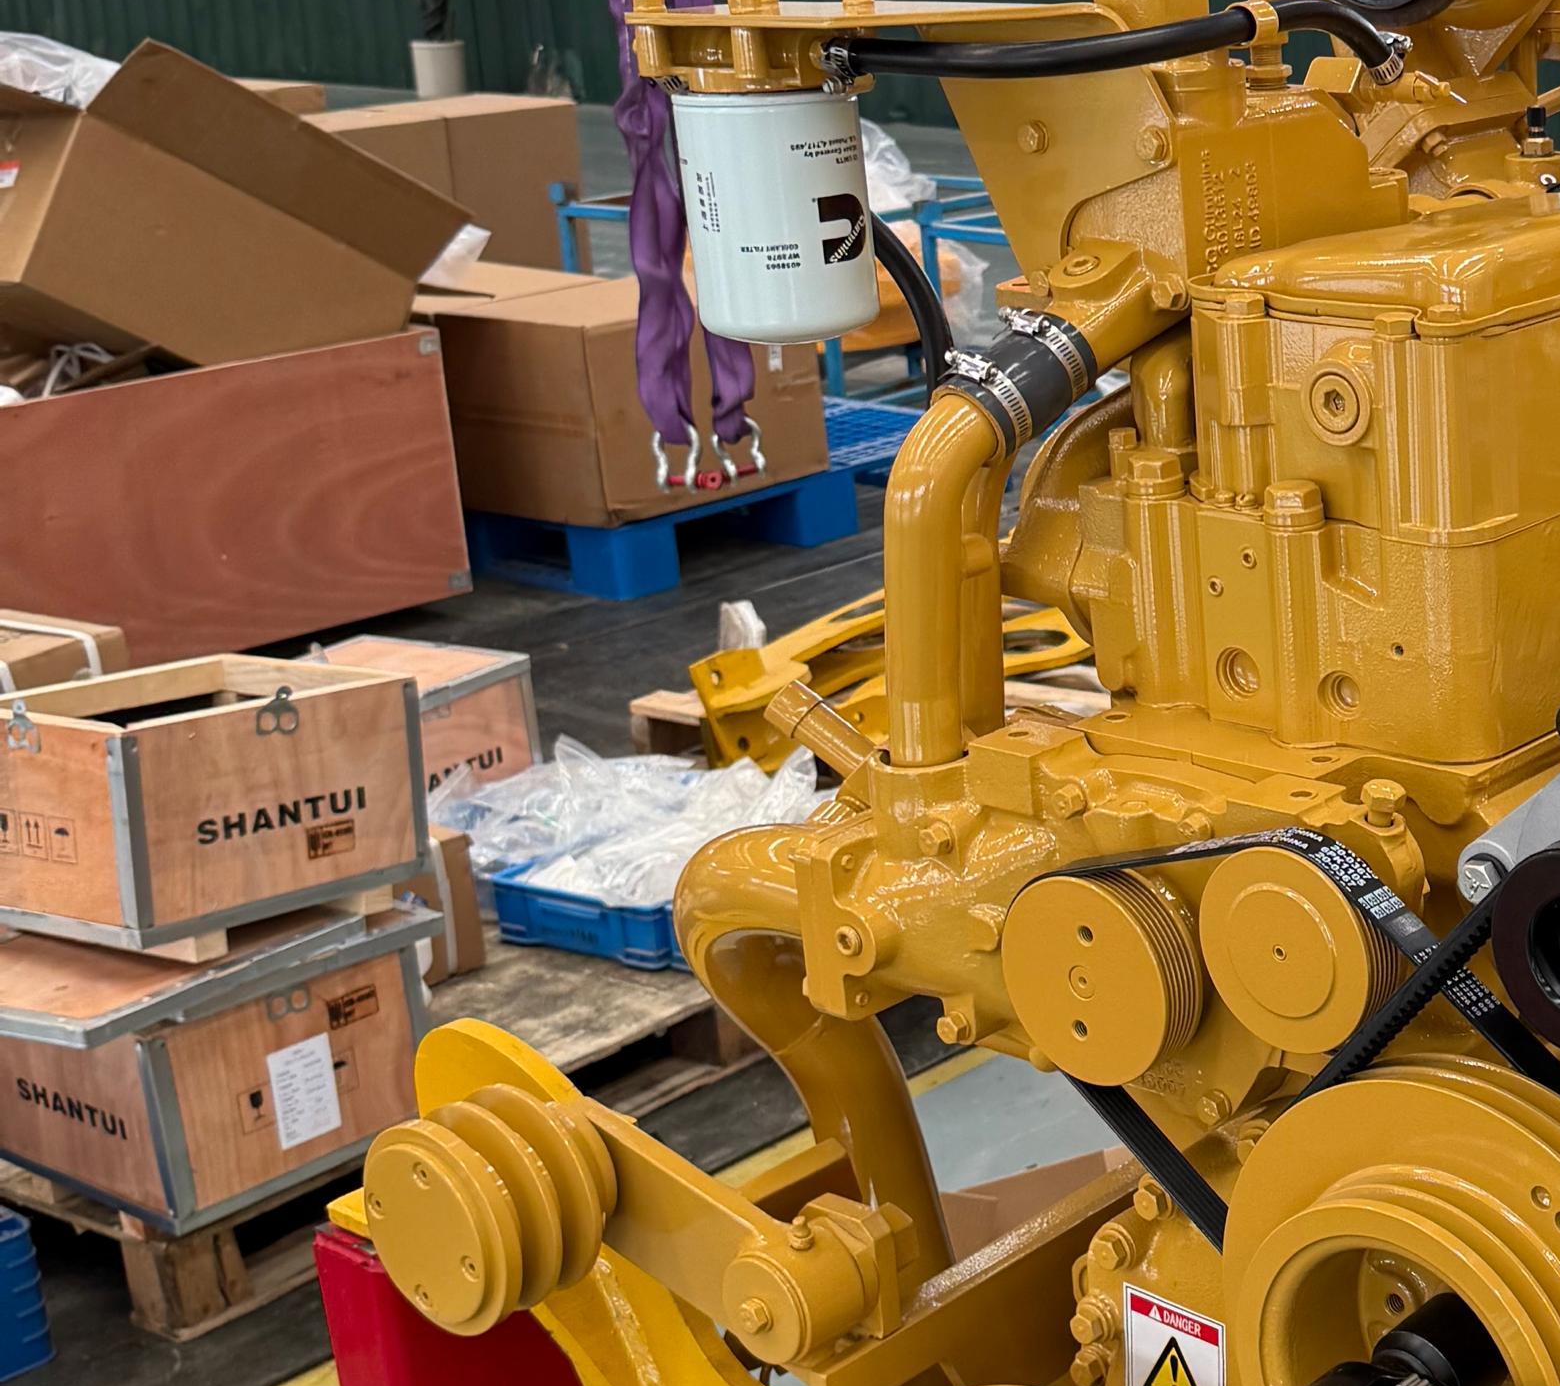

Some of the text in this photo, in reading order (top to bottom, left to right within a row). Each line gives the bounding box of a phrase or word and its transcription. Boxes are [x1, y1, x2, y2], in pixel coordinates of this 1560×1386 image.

[428, 746, 503, 793] ATUI
[197, 786, 366, 845] SHANTUI
[1314, 851, 1357, 887] 20-0367
[1321, 846, 1366, 886] 6PK1105
[17, 1077, 127, 1141] SHANTUI
[1162, 1309, 1202, 1338] DANGER
